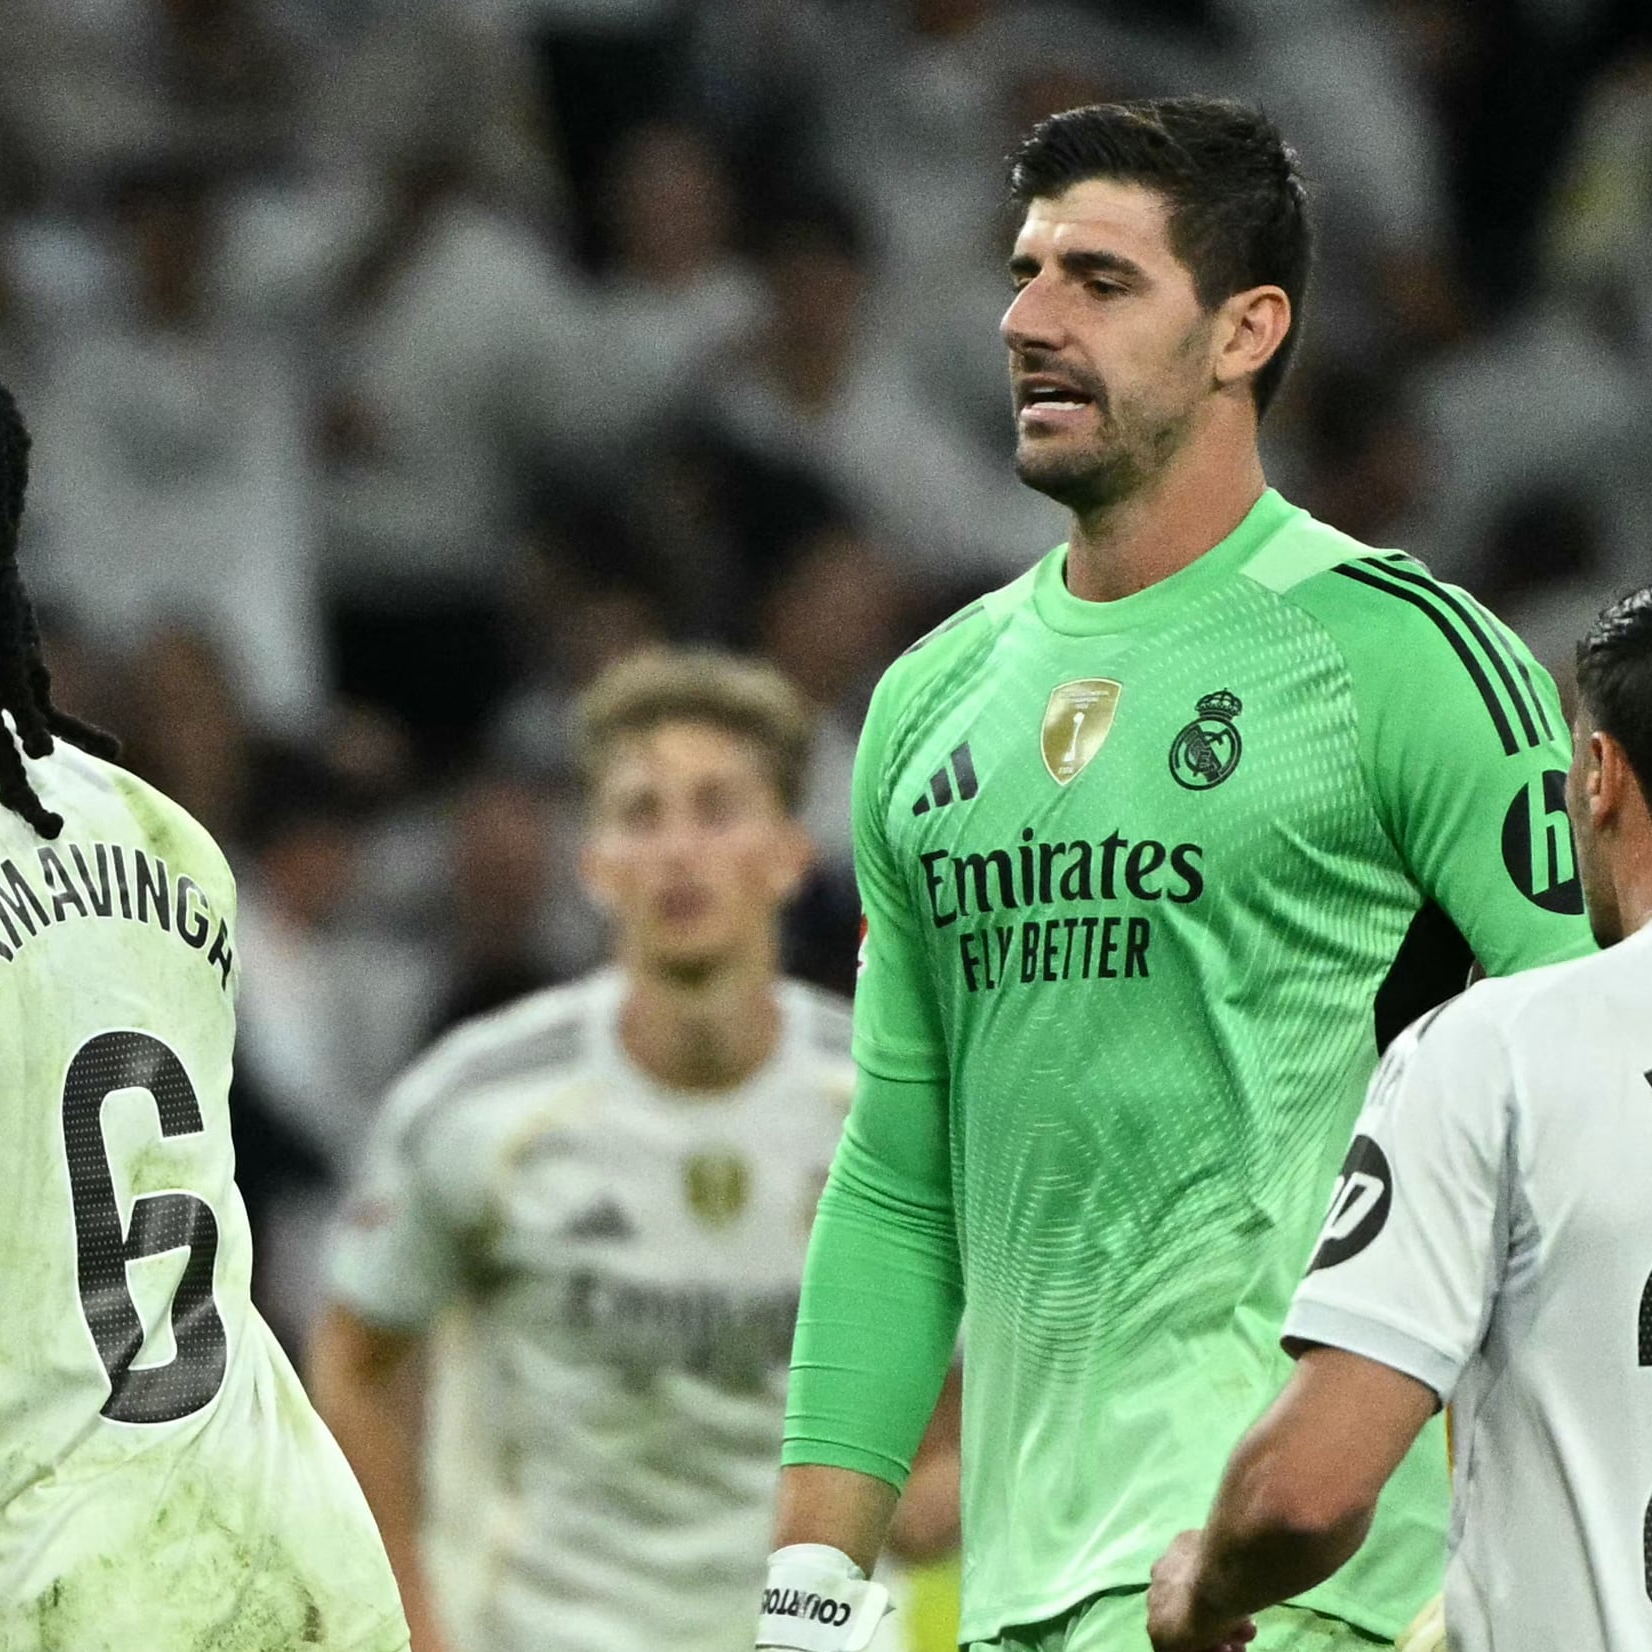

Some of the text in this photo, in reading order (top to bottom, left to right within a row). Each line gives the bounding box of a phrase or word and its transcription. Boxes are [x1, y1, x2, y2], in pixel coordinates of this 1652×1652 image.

[920, 827, 1205, 928] Emirates
[959, 917, 1150, 992] FLY BETTER
[60, 1030, 228, 1424] 6
